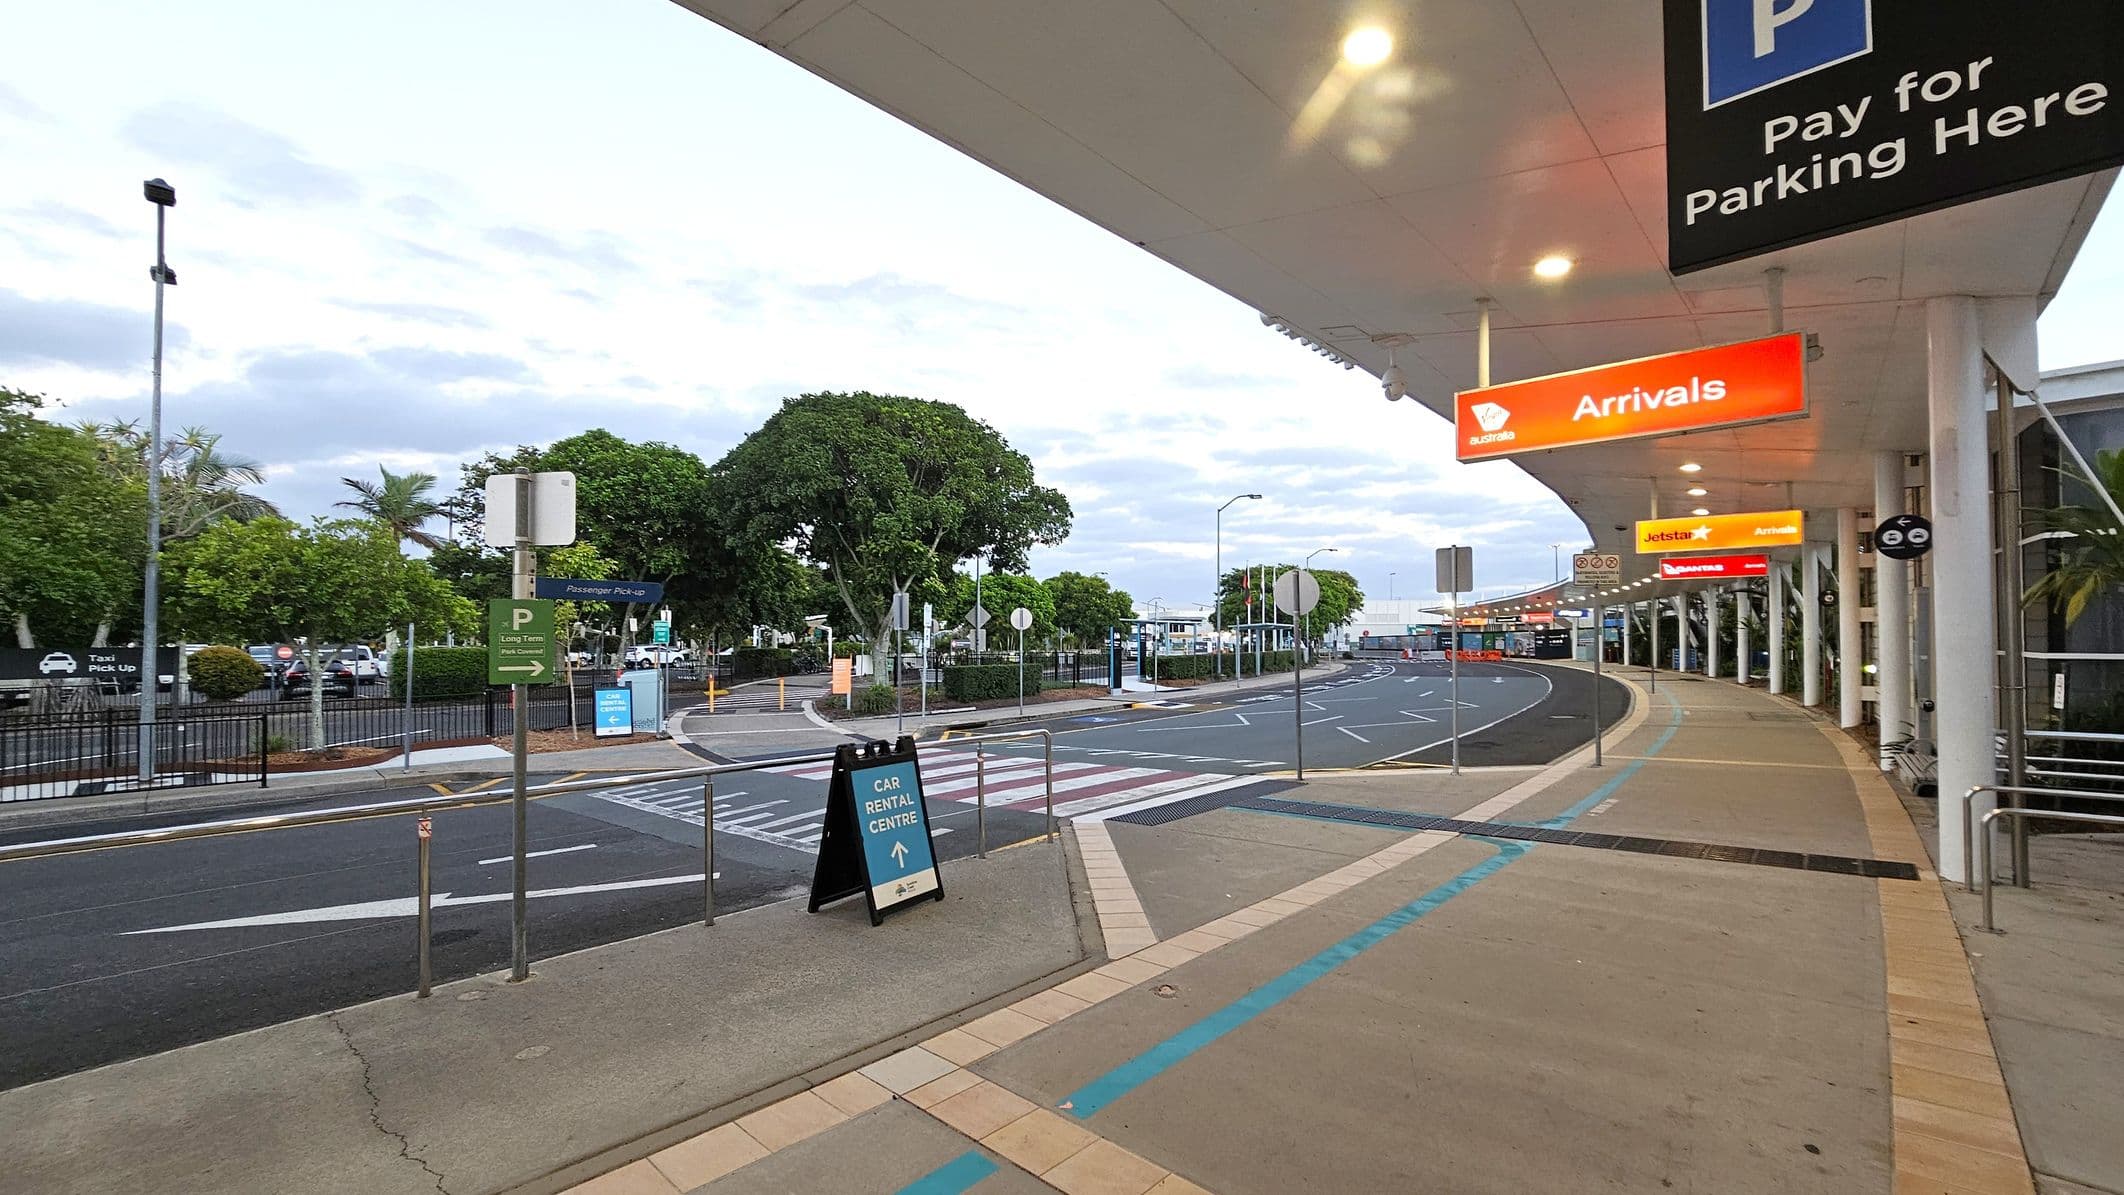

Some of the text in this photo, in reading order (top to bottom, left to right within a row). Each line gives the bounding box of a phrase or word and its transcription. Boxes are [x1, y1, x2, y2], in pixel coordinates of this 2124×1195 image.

[1764, 56, 1993, 154] Pay for
[1685, 81, 2108, 226] Parking Here
[1572, 375, 1727, 421] Arrivals
[1469, 431, 1516, 446] australia
[1644, 524, 1798, 542] Jetstar Arrivals
[566, 585, 645, 596] Passenger Pick-up
[513, 608, 533, 631] P
[501, 635, 521, 643] Long
[88, 654, 115, 662] Taxi
[88, 664, 136, 672] Pick Up
[874, 776, 900, 793] CAR
[865, 793, 914, 815] RENTAL
[869, 811, 918, 834] CENTRE
